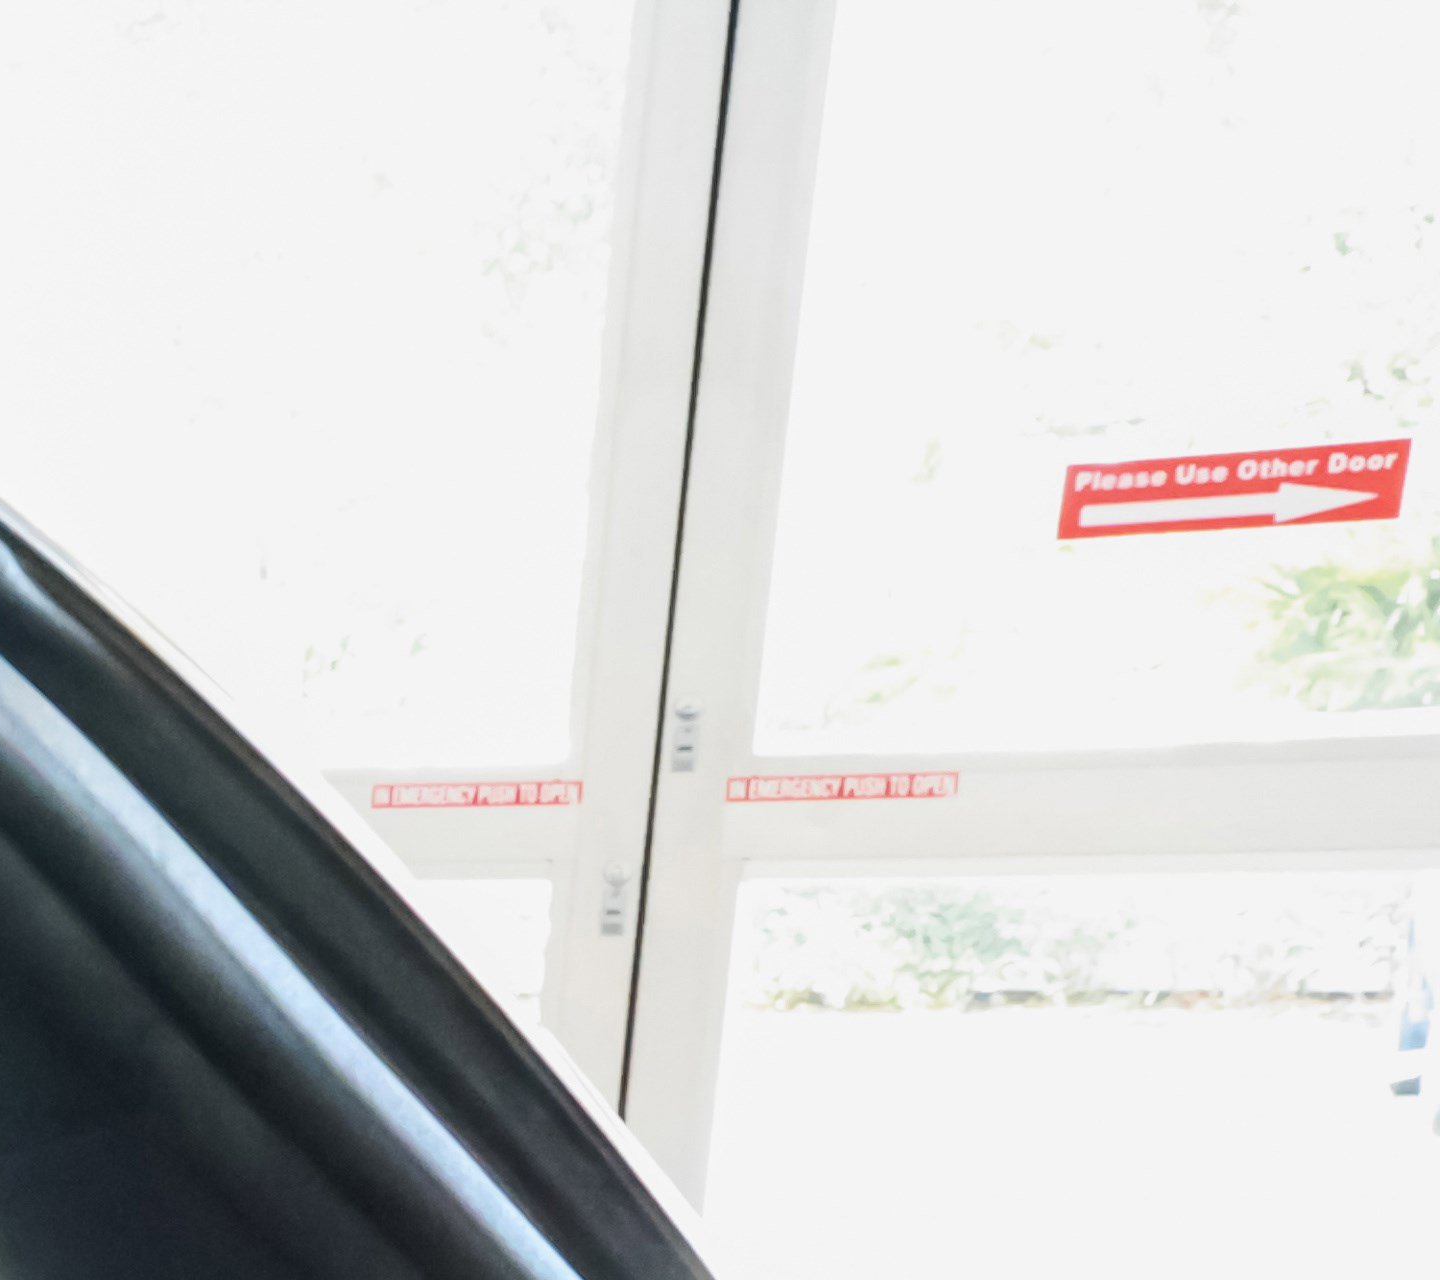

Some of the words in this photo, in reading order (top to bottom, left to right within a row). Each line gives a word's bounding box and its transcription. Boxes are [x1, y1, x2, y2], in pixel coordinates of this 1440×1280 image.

[1075, 471, 1167, 492] Please
[1175, 464, 1228, 486] Use
[1237, 457, 1319, 481] Other
[1327, 452, 1398, 475] Door
[393, 784, 475, 805] EMERGENCY
[479, 784, 516, 804] PUSH
[520, 783, 537, 803] TO
[541, 782, 580, 803] OPEN
[749, 777, 841, 799] EMERGENCY
[844, 776, 886, 798] PUSH
[890, 775, 909, 797] TO
[914, 774, 955, 796] OPEN
